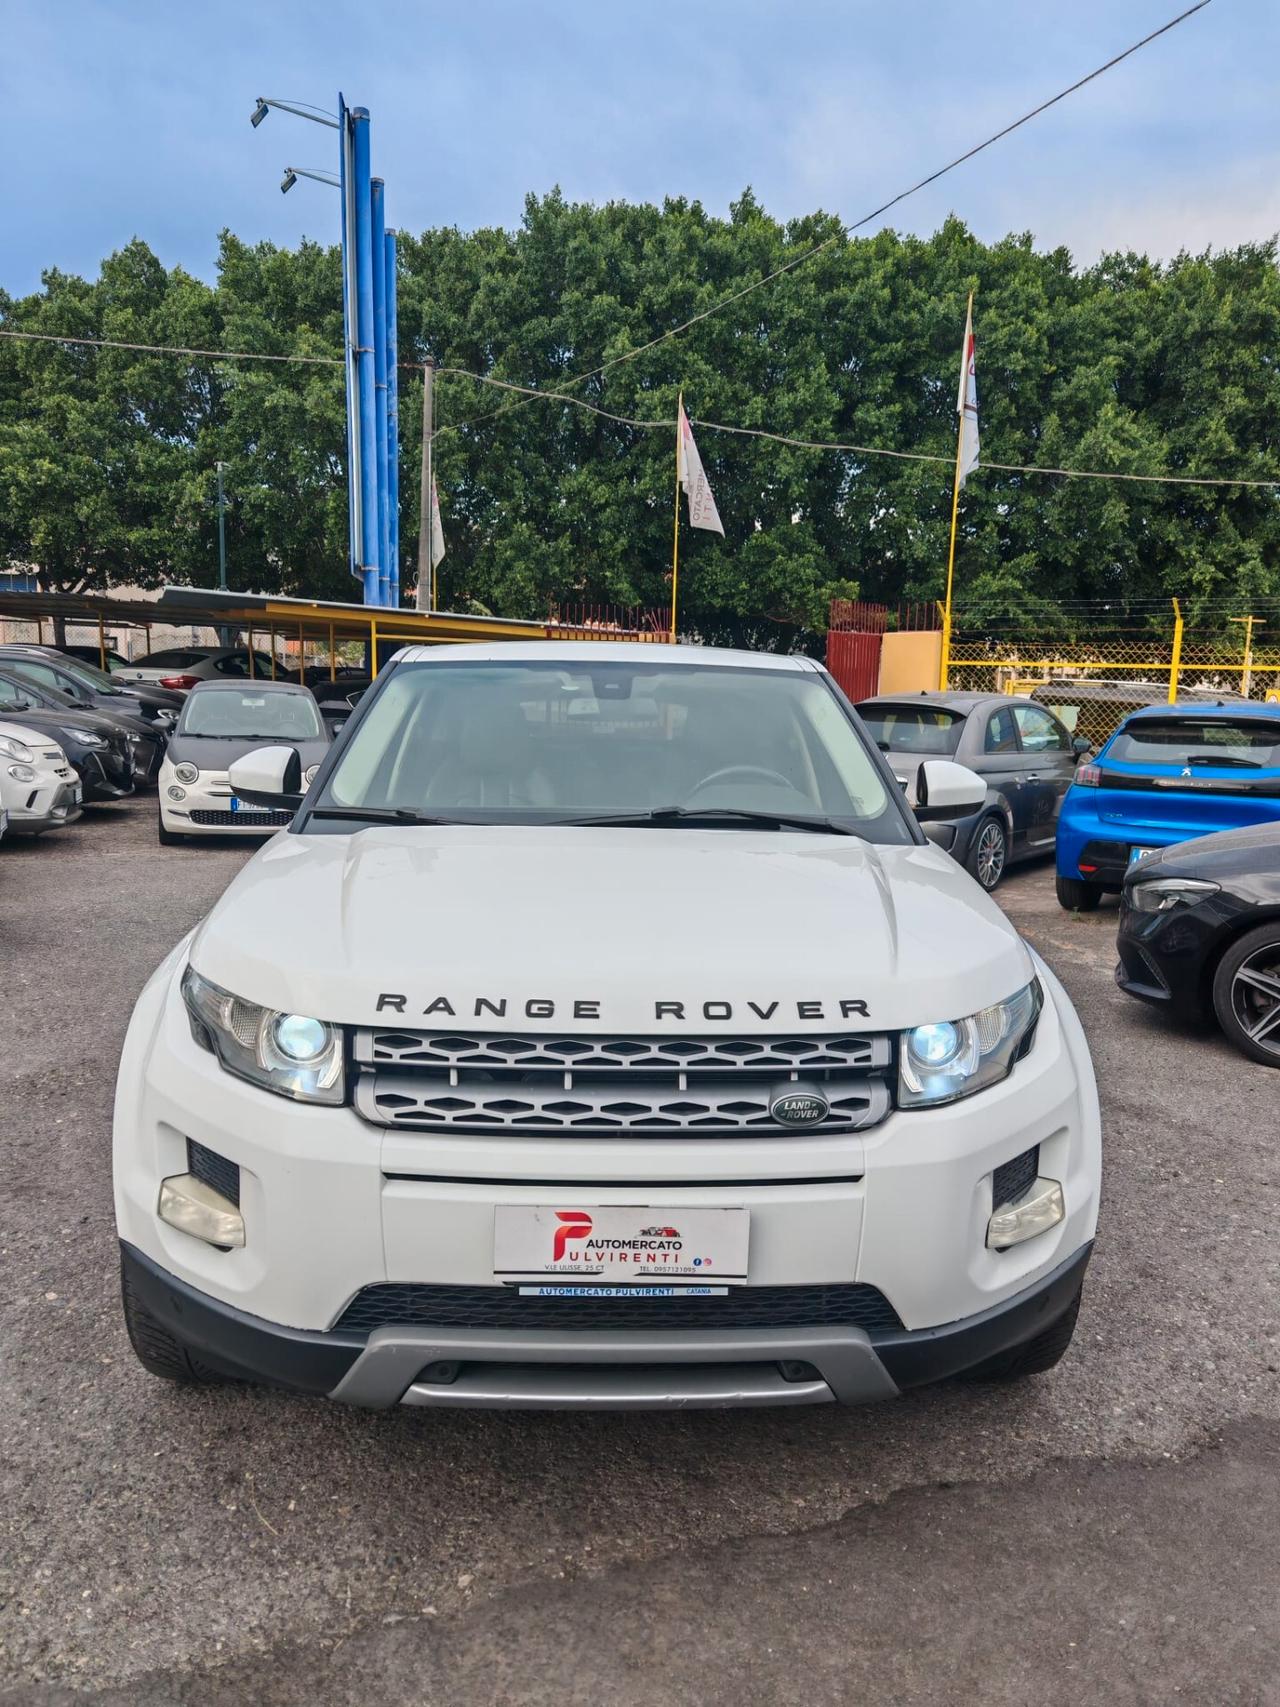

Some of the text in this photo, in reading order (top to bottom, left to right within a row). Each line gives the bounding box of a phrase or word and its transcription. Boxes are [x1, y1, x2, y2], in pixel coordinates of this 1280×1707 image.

[376, 993, 871, 1020] RANGE ROVER
[784, 1101, 811, 1110] LAND
[786, 1109, 819, 1119] ROVER
[586, 1239, 682, 1251] AUTOMERCATO
[539, 1287, 712, 1296] AUTOMERCATO PULVIRENTI CATANIA
